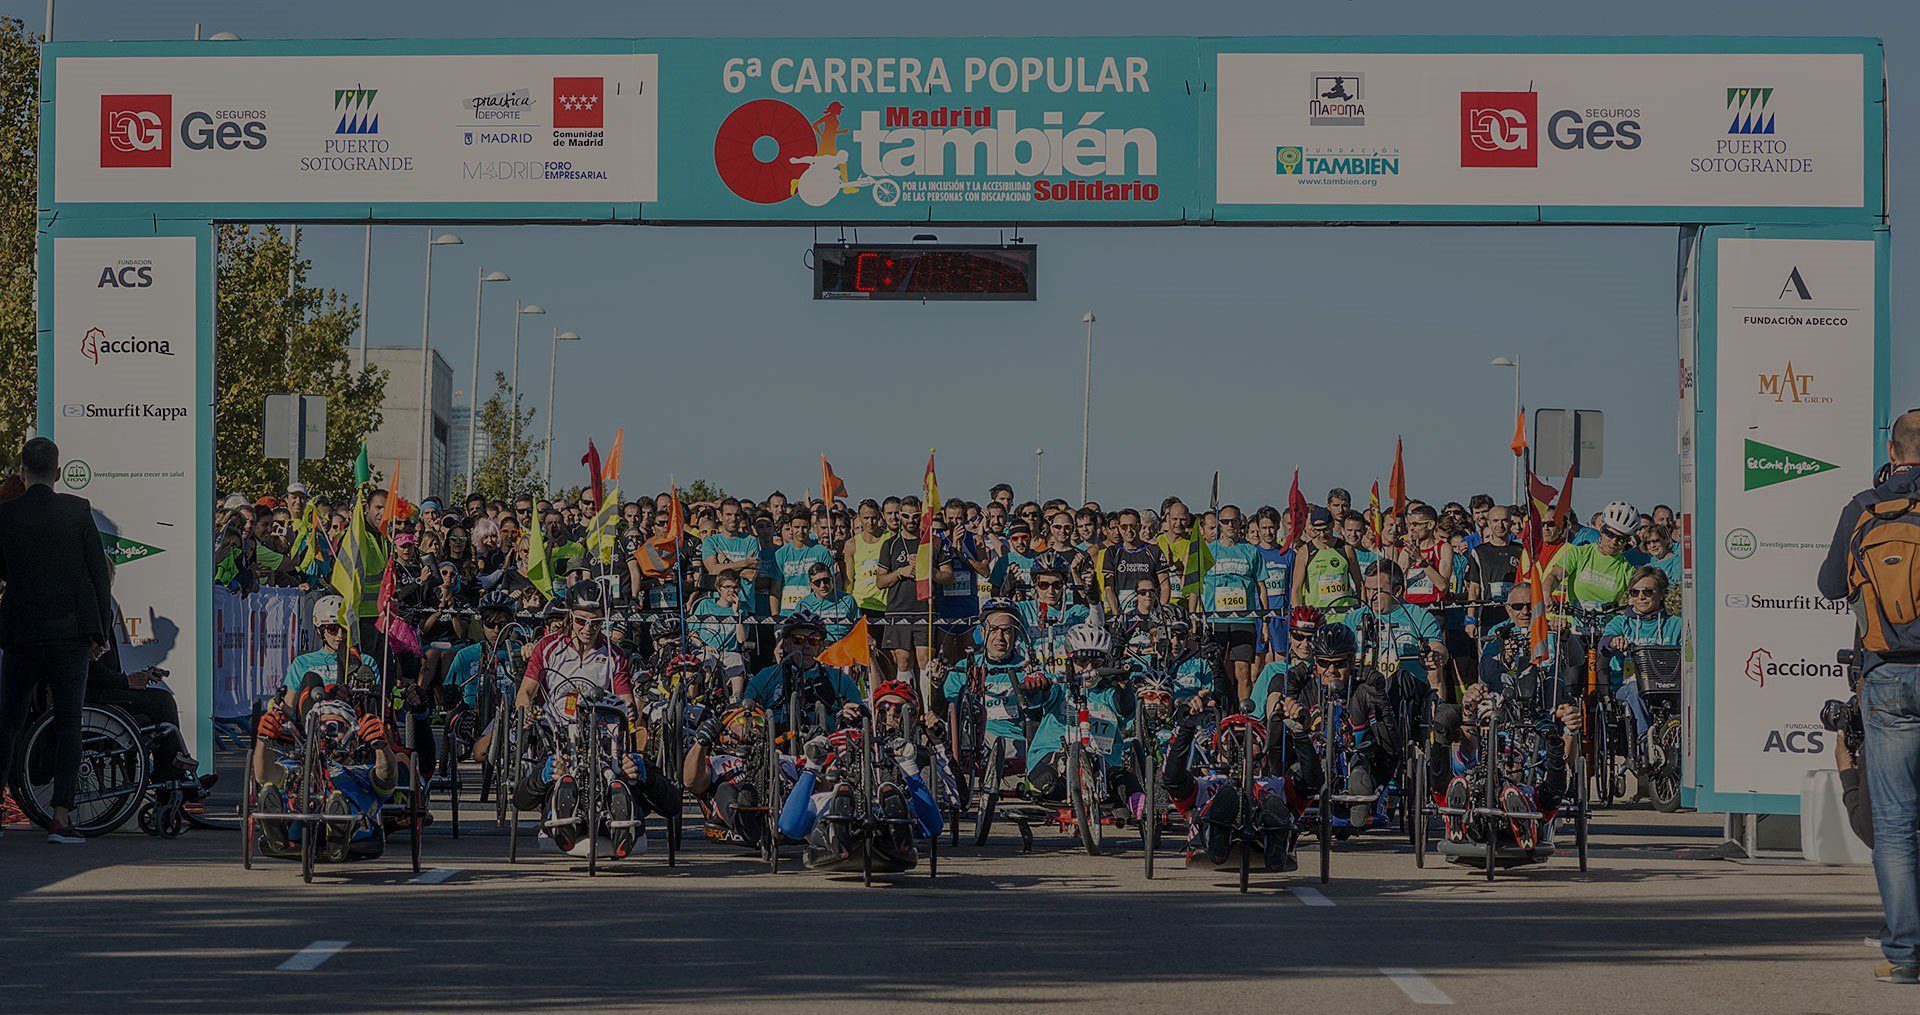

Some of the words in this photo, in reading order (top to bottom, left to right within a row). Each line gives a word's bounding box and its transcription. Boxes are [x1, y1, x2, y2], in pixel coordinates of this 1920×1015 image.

[770, 57, 952, 93] CARRERA
[964, 57, 1150, 93] POPULAR
[215, 110, 267, 119] SEGUROS
[478, 110, 521, 120] DEPORTE
[885, 105, 992, 128] Madrid
[1585, 108, 1641, 118] SEGUROS
[180, 110, 268, 151] Ges
[553, 130, 604, 138] Comunidad
[1548, 109, 1642, 151] Ges
[480, 133, 533, 144] MADRID
[553, 138, 565, 147] de
[568, 138, 604, 147] Madrid
[853, 109, 1158, 177] también
[324, 139, 389, 154] PUERTO
[1716, 139, 1787, 155] PUERTO
[300, 156, 414, 172] SOTOGRANDE
[545, 161, 572, 171] FORO
[1305, 152, 1399, 175] TAMBIÉN
[1691, 158, 1813, 173] SOTOGRANDE
[545, 171, 608, 180] EMPRESARIAL
[1297, 177, 1377, 186] www.tambien.org
[902, 181, 917, 191] POR
[918, 181, 927, 191] LA
[928, 179, 964, 191] INCLUSIÓN
[972, 181, 981, 191] LA
[982, 181, 1031, 191] ACCESIBILIDAD
[1032, 179, 1160, 202] Solidario
[902, 192, 911, 202] DE
[913, 192, 925, 202] LAS
[927, 192, 963, 202] PERSONAS
[965, 192, 980, 202] CON
[981, 192, 1031, 202] DISCAPACIDAD
[97, 266, 153, 288] ACS
[1743, 315, 1803, 326] FUNDACIÓN
[1805, 316, 1848, 326] ADECCO
[100, 336, 170, 354] acciona
[1804, 396, 1833, 404] GRUPO
[86, 403, 141, 418] Smurfit
[142, 403, 188, 420] Kappa
[1758, 457, 1784, 470] Corte
[1760, 541, 1799, 549] Investigamos
[1223, 597, 1244, 605] 1260
[1751, 594, 1811, 610] Smurfit
[1814, 596, 1851, 615] Kapp
[1766, 659, 1843, 677] acciona
[1763, 731, 1824, 754] ACS
